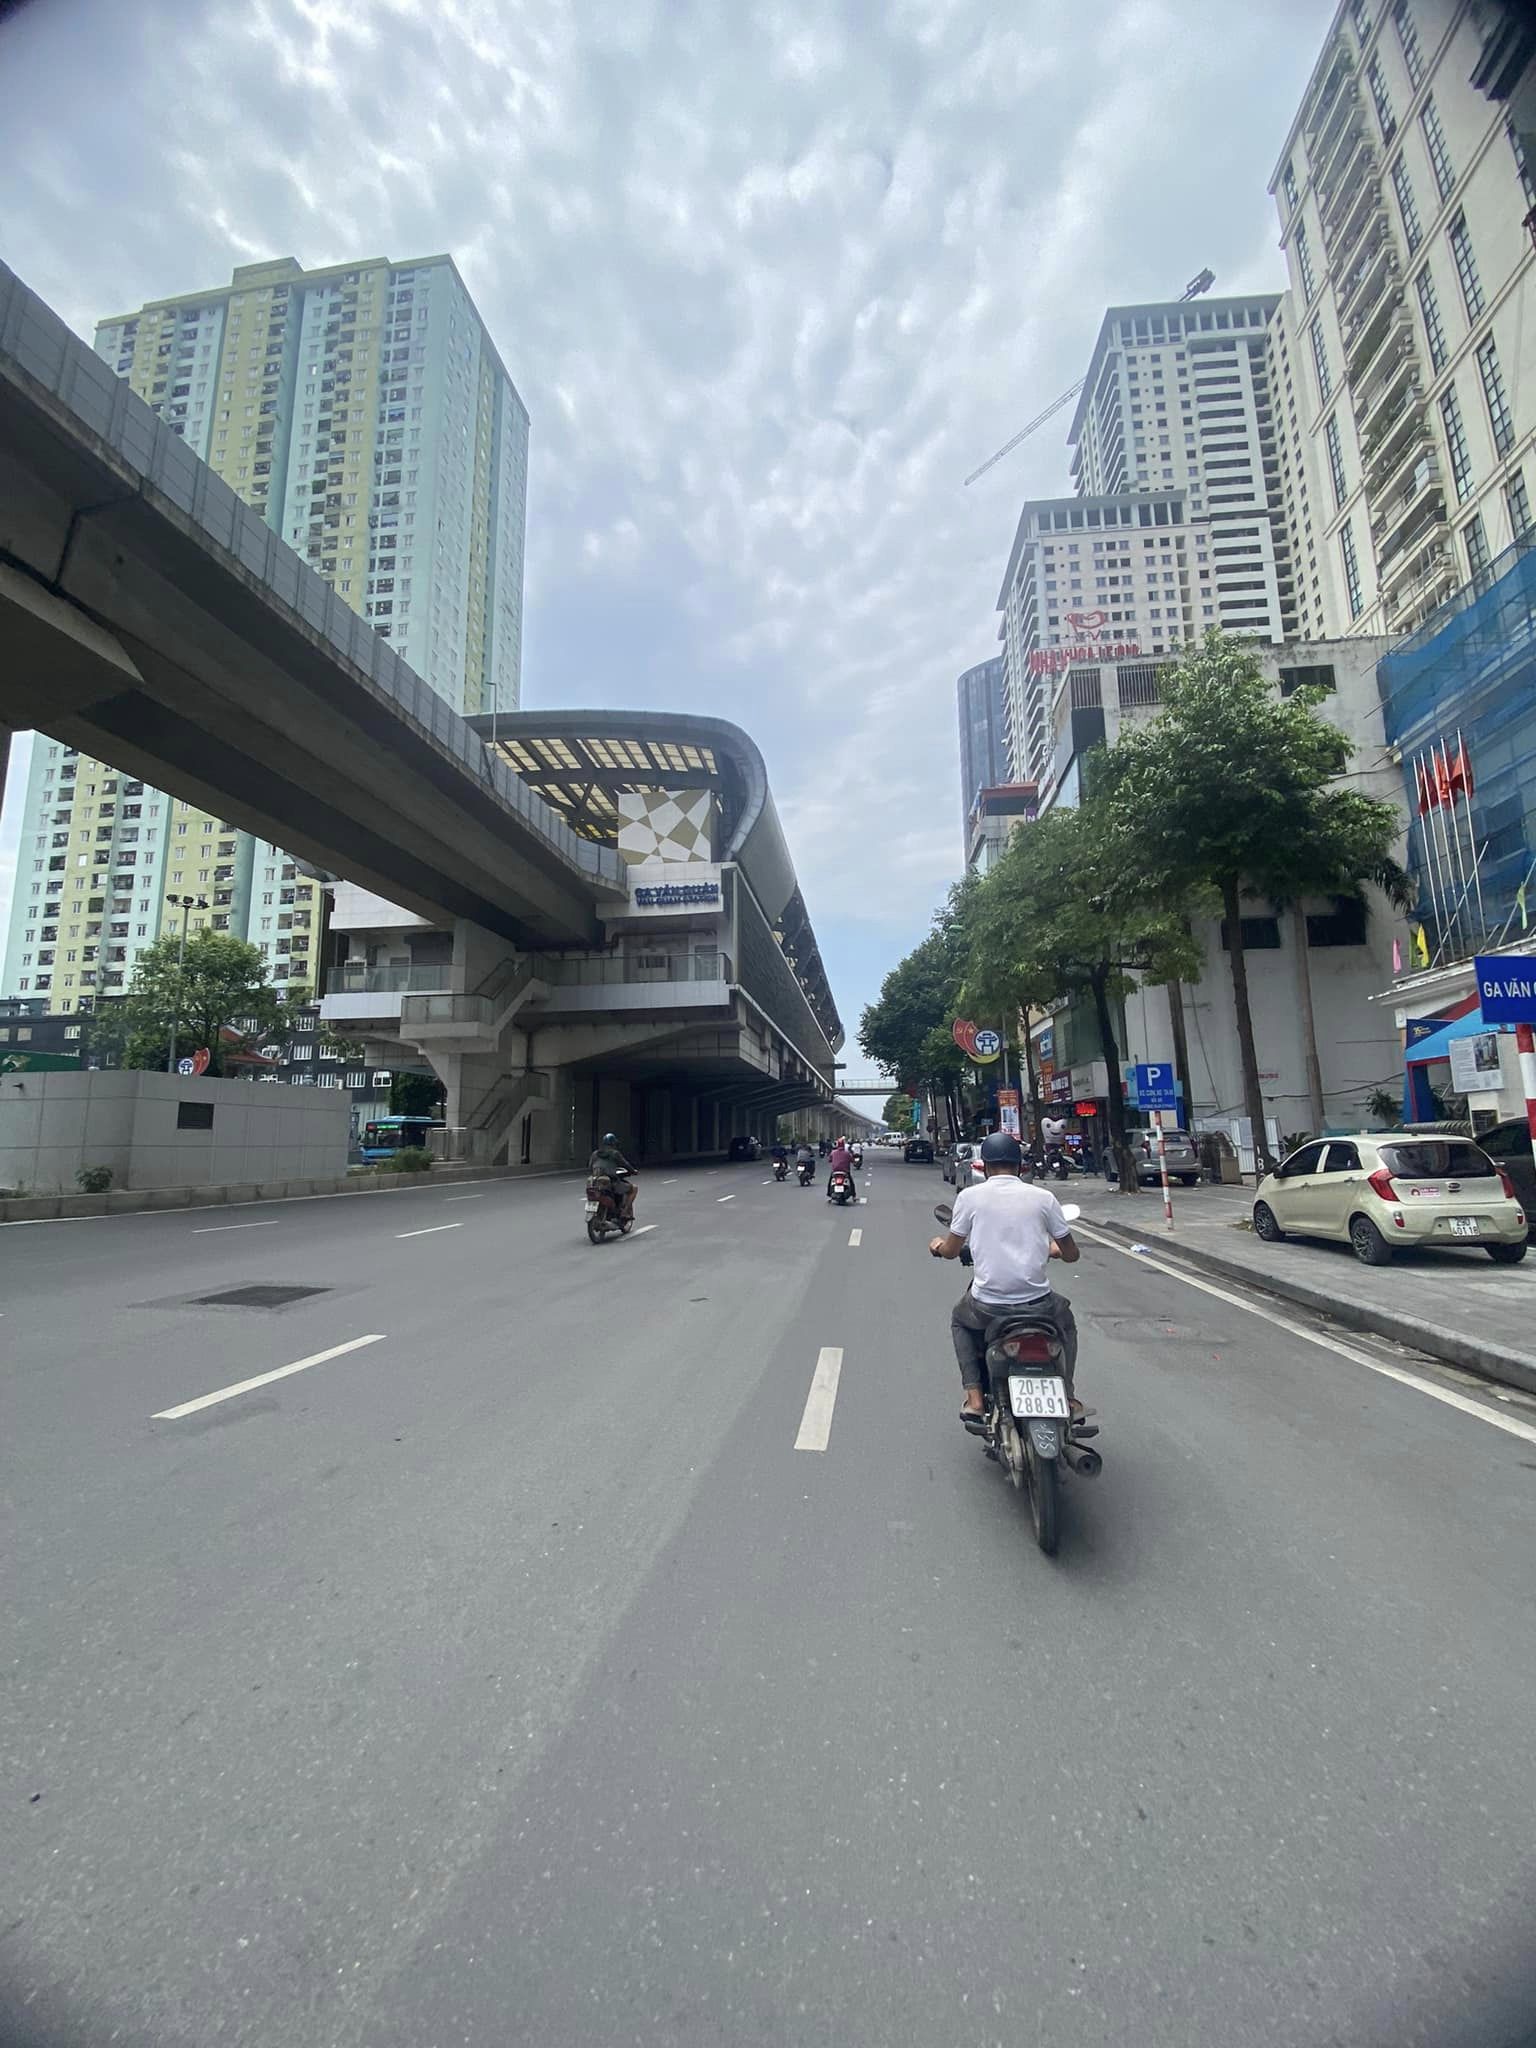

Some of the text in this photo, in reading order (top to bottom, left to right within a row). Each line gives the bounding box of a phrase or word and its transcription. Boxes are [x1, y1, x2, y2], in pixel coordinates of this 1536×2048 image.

[1483, 981, 1503, 998] GA
[1503, 977, 1532, 998] VĂN
[1147, 1067, 1161, 1087] P
[1018, 1379, 1057, 1396] 20-F1
[1016, 1396, 1066, 1415] 288.91
